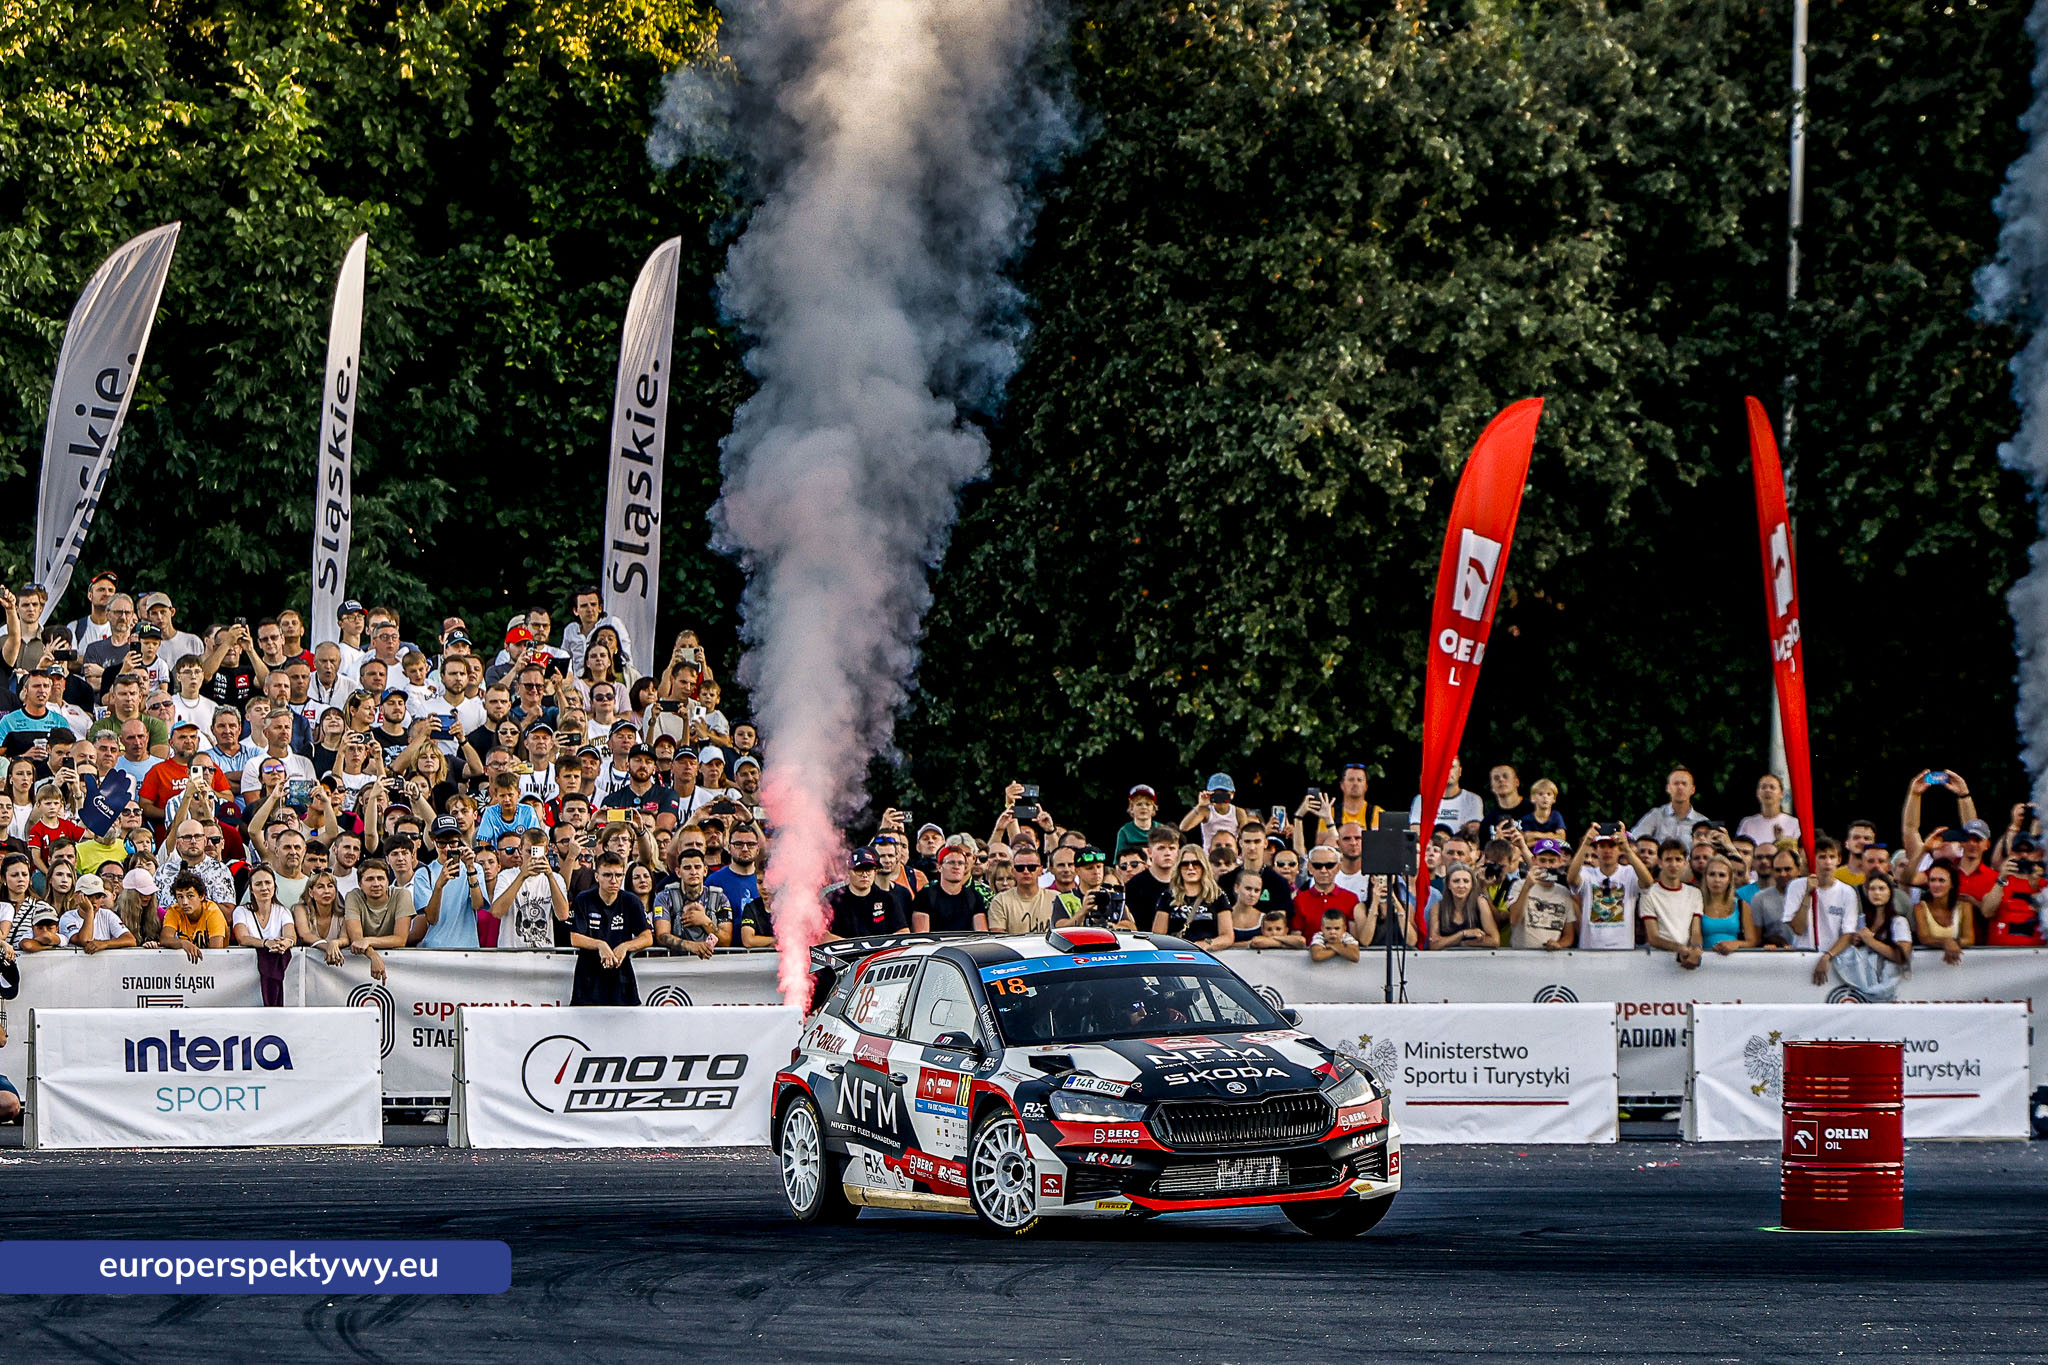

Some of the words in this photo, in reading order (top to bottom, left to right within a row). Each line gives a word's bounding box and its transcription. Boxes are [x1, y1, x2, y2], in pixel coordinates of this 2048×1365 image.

[607, 359, 660, 599] Śląskie.
[97, 800, 115, 816] moya
[122, 977, 171, 990] STADION
[174, 972, 215, 992] ŚLĄSKI
[990, 977, 1028, 996] 18
[852, 984, 875, 1024] 18
[124, 1029, 294, 1073] interia
[816, 1032, 848, 1055] ORLEN
[1404, 1040, 1529, 1060] Ministerstwo
[982, 1057, 999, 1068] RX
[1145, 1048, 1267, 1065] NFM
[573, 1054, 749, 1084] MOTO
[1404, 1067, 1468, 1088] Sportu
[1473, 1066, 1478, 1084] i
[1484, 1066, 1570, 1088] Turystyki
[959, 1074, 972, 1107] 18
[1097, 1080, 1124, 1093] 0505
[156, 1085, 266, 1112] SPORT
[568, 1090, 735, 1110] WIZJA
[836, 1073, 898, 1135] NFM
[1023, 1102, 1048, 1114] RX
[1348, 1111, 1367, 1123] BERG
[830, 1120, 857, 1133] NIVETTE
[857, 1127, 871, 1137] FLEET
[871, 1132, 901, 1149] MANAGEMENT
[1107, 1129, 1140, 1138] BERG
[1824, 1128, 1869, 1140] ORLEN
[1825, 1142, 1842, 1150] OIL
[864, 1152, 885, 1176] RX
[916, 1157, 934, 1172] BERG
[866, 1173, 888, 1185] POLSKA
[1097, 1201, 1129, 1210] PIRELLI
